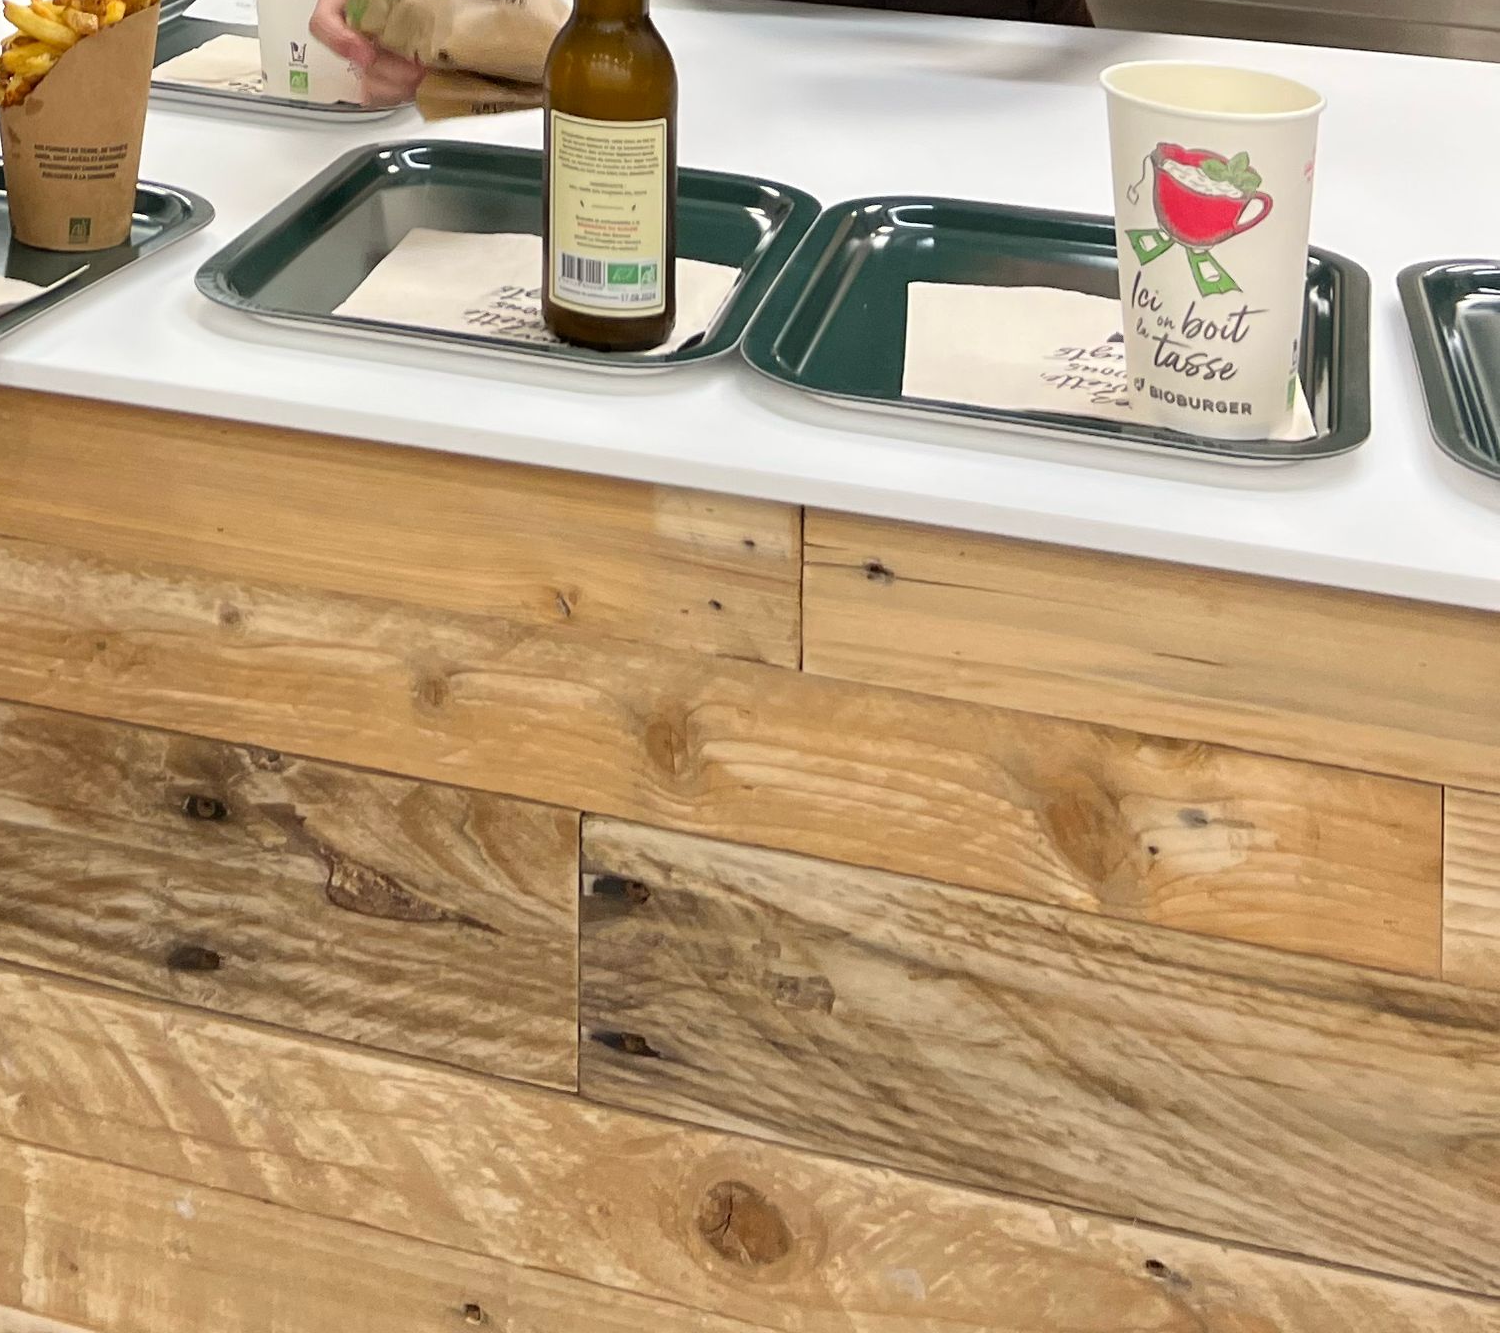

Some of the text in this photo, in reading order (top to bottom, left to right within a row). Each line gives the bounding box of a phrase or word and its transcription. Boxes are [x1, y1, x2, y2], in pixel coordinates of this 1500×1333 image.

[1131, 270, 1271, 344] Ici on boit
[1152, 333, 1238, 381] tasse
[1149, 384, 1253, 416] BIOBURGER
